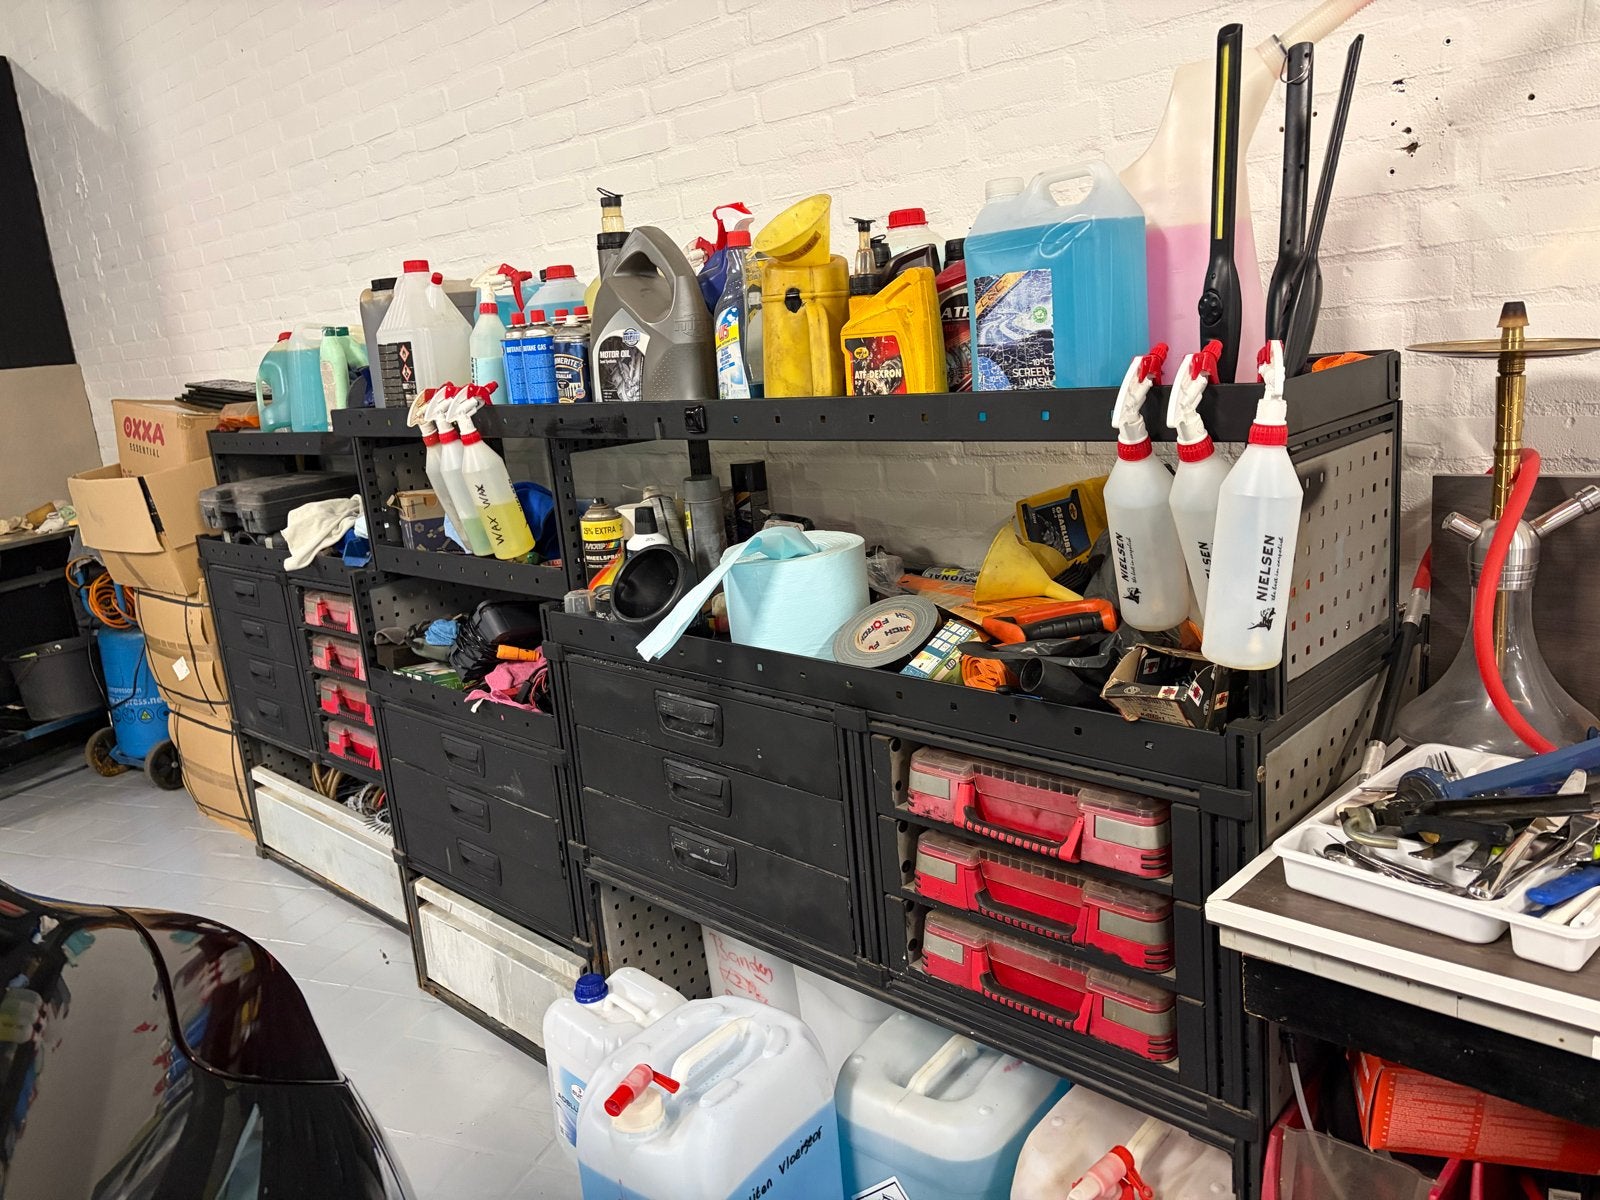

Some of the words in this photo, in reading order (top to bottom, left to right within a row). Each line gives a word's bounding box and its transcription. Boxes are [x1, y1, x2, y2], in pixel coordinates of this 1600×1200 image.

[600, 350, 619, 358] MOTOR
[620, 349, 631, 358] OIL
[855, 370, 867, 380] ATF
[869, 368, 902, 379] DEXRON
[1012, 367, 1050, 378] SCREEN
[1023, 377, 1052, 387] WASH
[123, 416, 165, 446] OXXA
[487, 515, 505, 546] WAX
[595, 525, 617, 535] EXTRA
[1056, 506, 1073, 553] GEARLUBE
[1115, 532, 1129, 582] NIELSEN
[1256, 534, 1275, 602] NIELSEN
